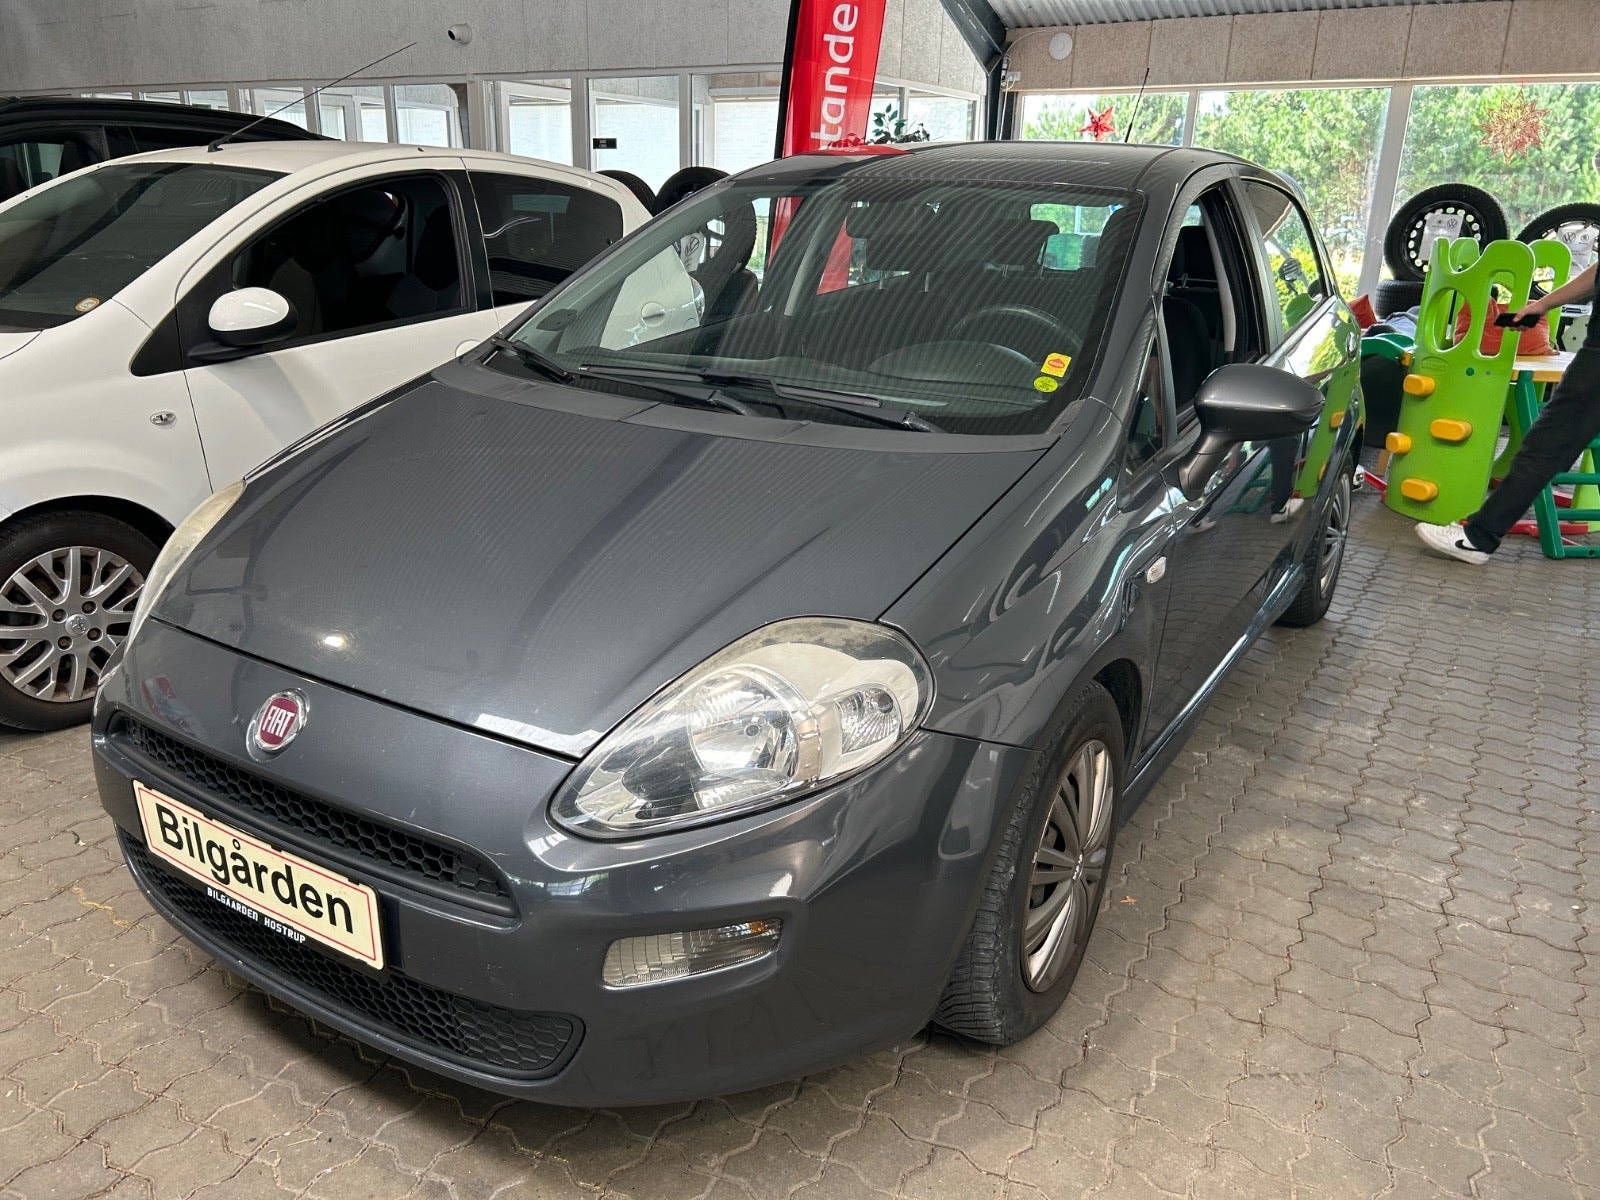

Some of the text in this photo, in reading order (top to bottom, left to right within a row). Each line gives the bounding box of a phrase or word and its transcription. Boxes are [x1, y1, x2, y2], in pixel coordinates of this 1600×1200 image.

[810, 3, 859, 149] tande
[262, 705, 295, 738] FIAT
[155, 803, 354, 934] Bilgården
[207, 887, 306, 944] BILGAARDEN HOSTRUP
